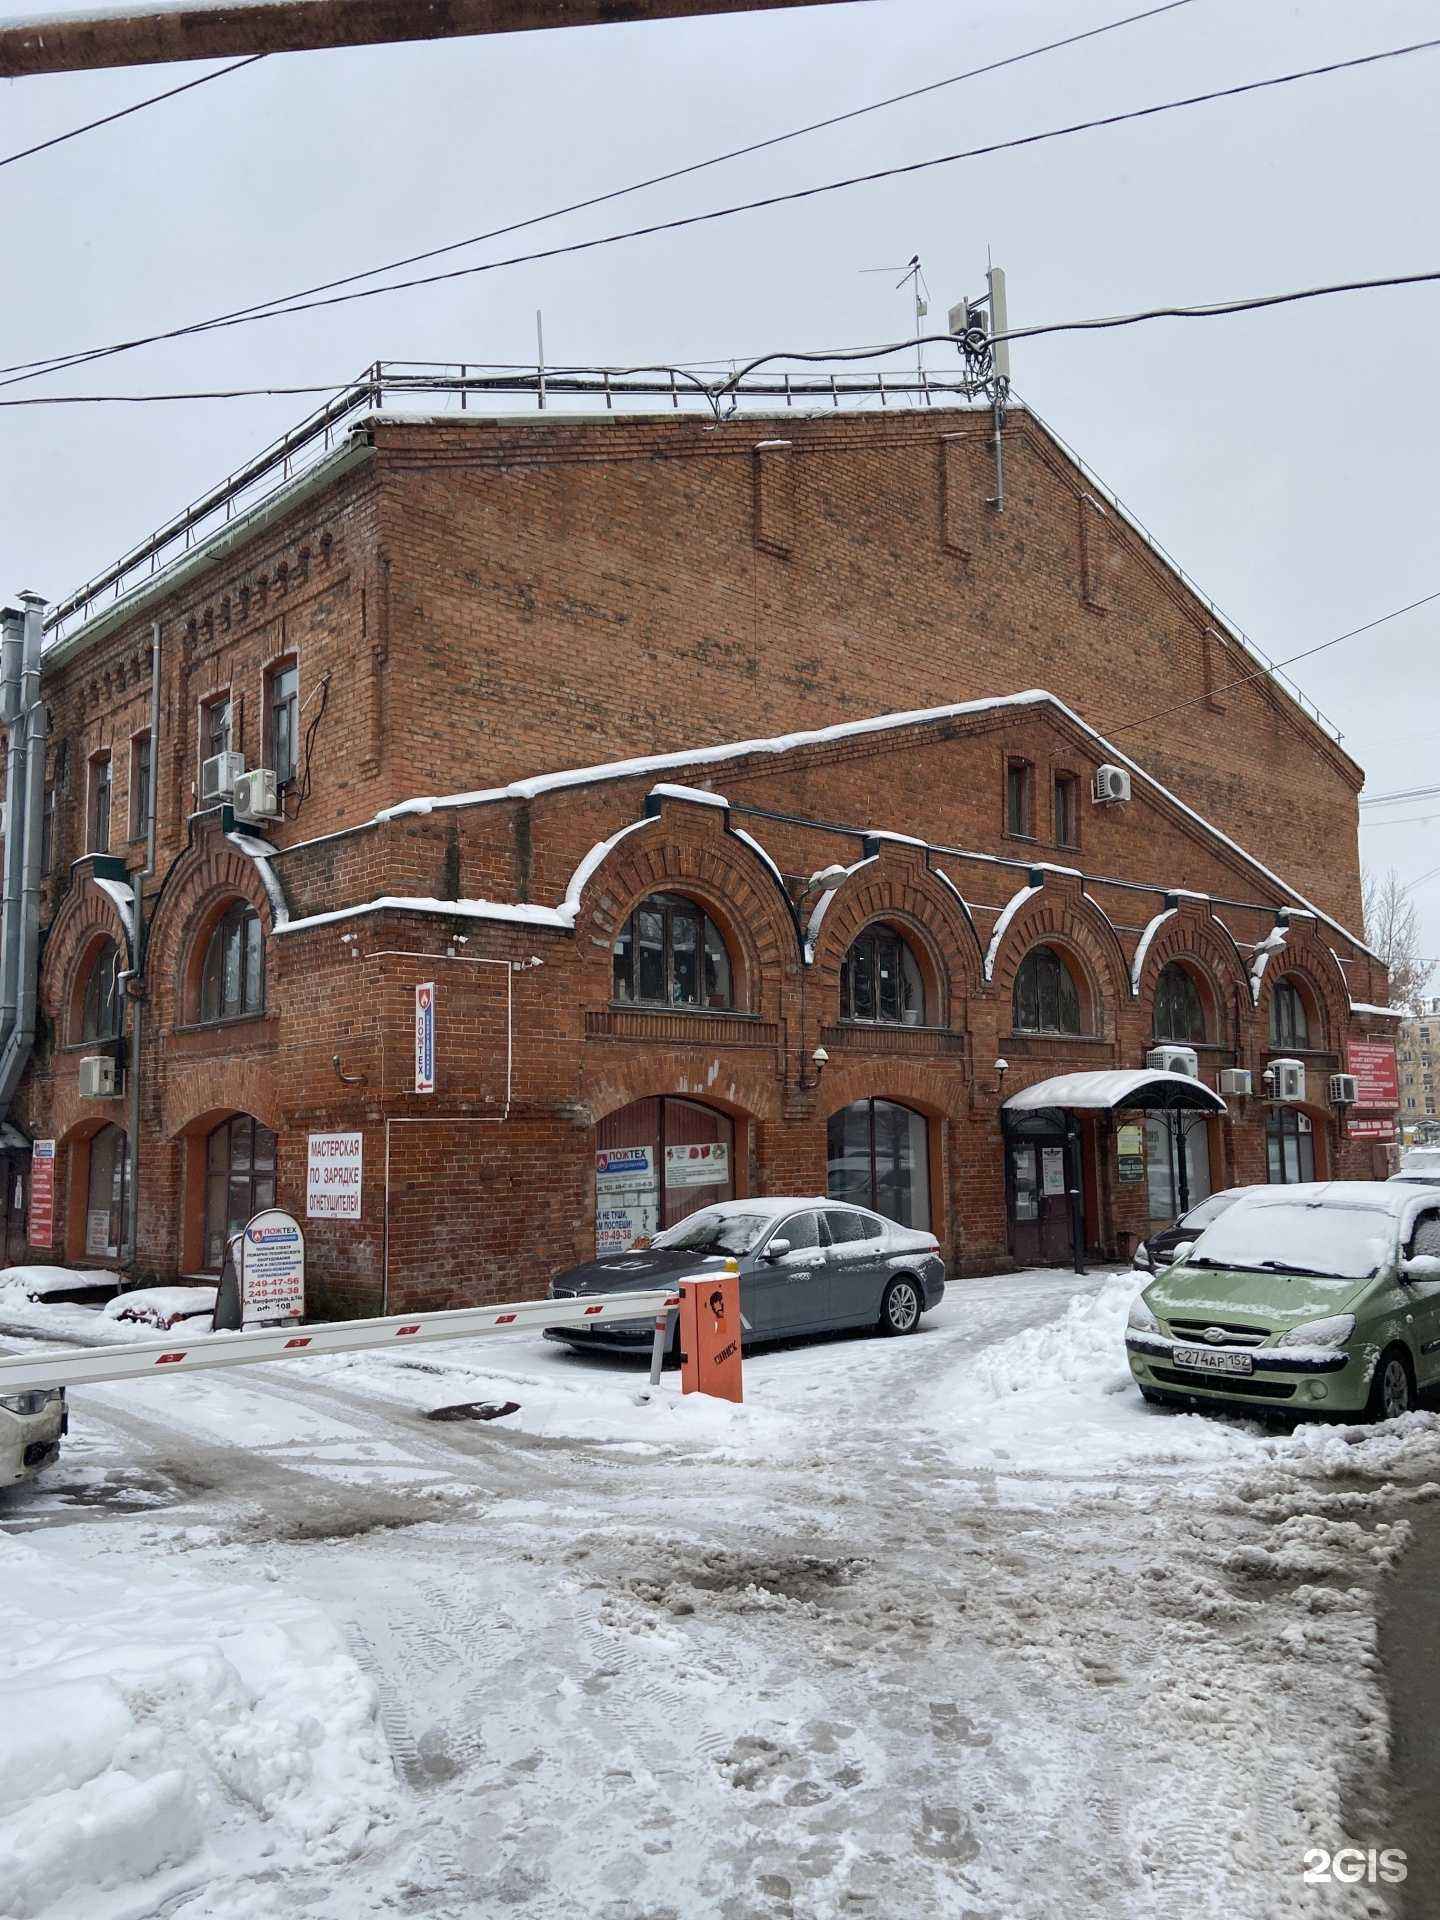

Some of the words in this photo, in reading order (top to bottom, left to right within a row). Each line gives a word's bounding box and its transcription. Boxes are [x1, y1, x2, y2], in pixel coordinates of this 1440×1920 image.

[311, 1140, 360, 1157] МАСТЕРСКАЯ
[609, 1149, 646, 1160] ПОЖТЕХ
[309, 1168, 320, 1184] ПО
[324, 1167, 360, 1186] ЗАРЯДКЕ
[309, 1192, 359, 1211] ОГНЕТУШИТЕЛЕЙ
[264, 1227, 297, 1235] ПОЖТЕХ
[248, 1278, 300, 1288] 249-47-56
[276, 1302, 291, 1310] 108
[1228, 1355, 1249, 1367] 152
